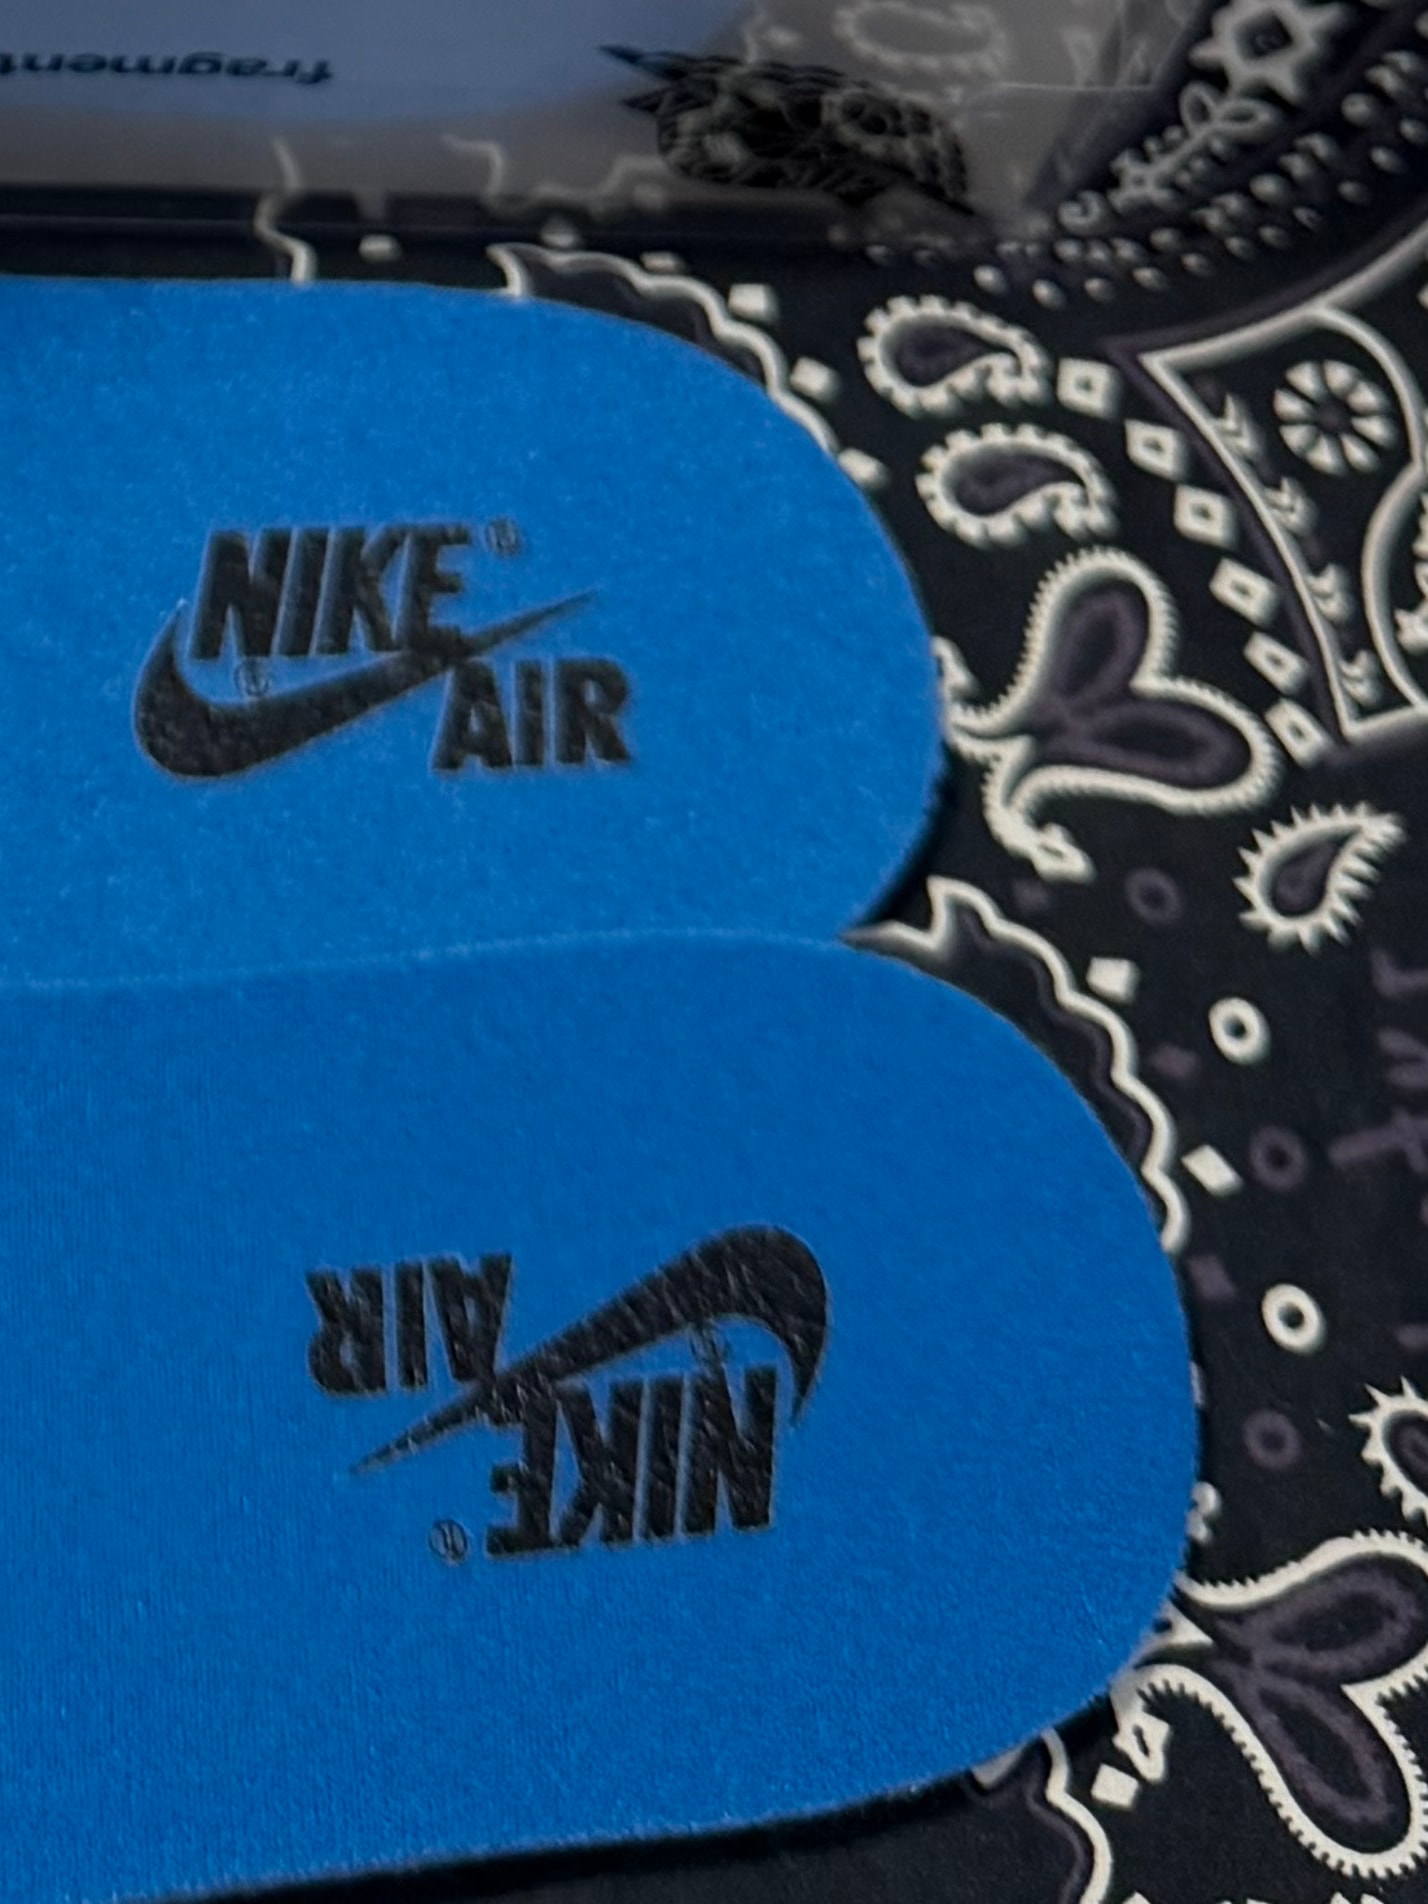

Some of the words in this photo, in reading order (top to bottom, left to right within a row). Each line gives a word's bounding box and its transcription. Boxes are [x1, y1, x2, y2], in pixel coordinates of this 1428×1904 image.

[188, 523, 470, 661] NIKE
[430, 656, 632, 772] AIR
[305, 1252, 513, 1393] AIR
[485, 1365, 777, 1558] NIKE
